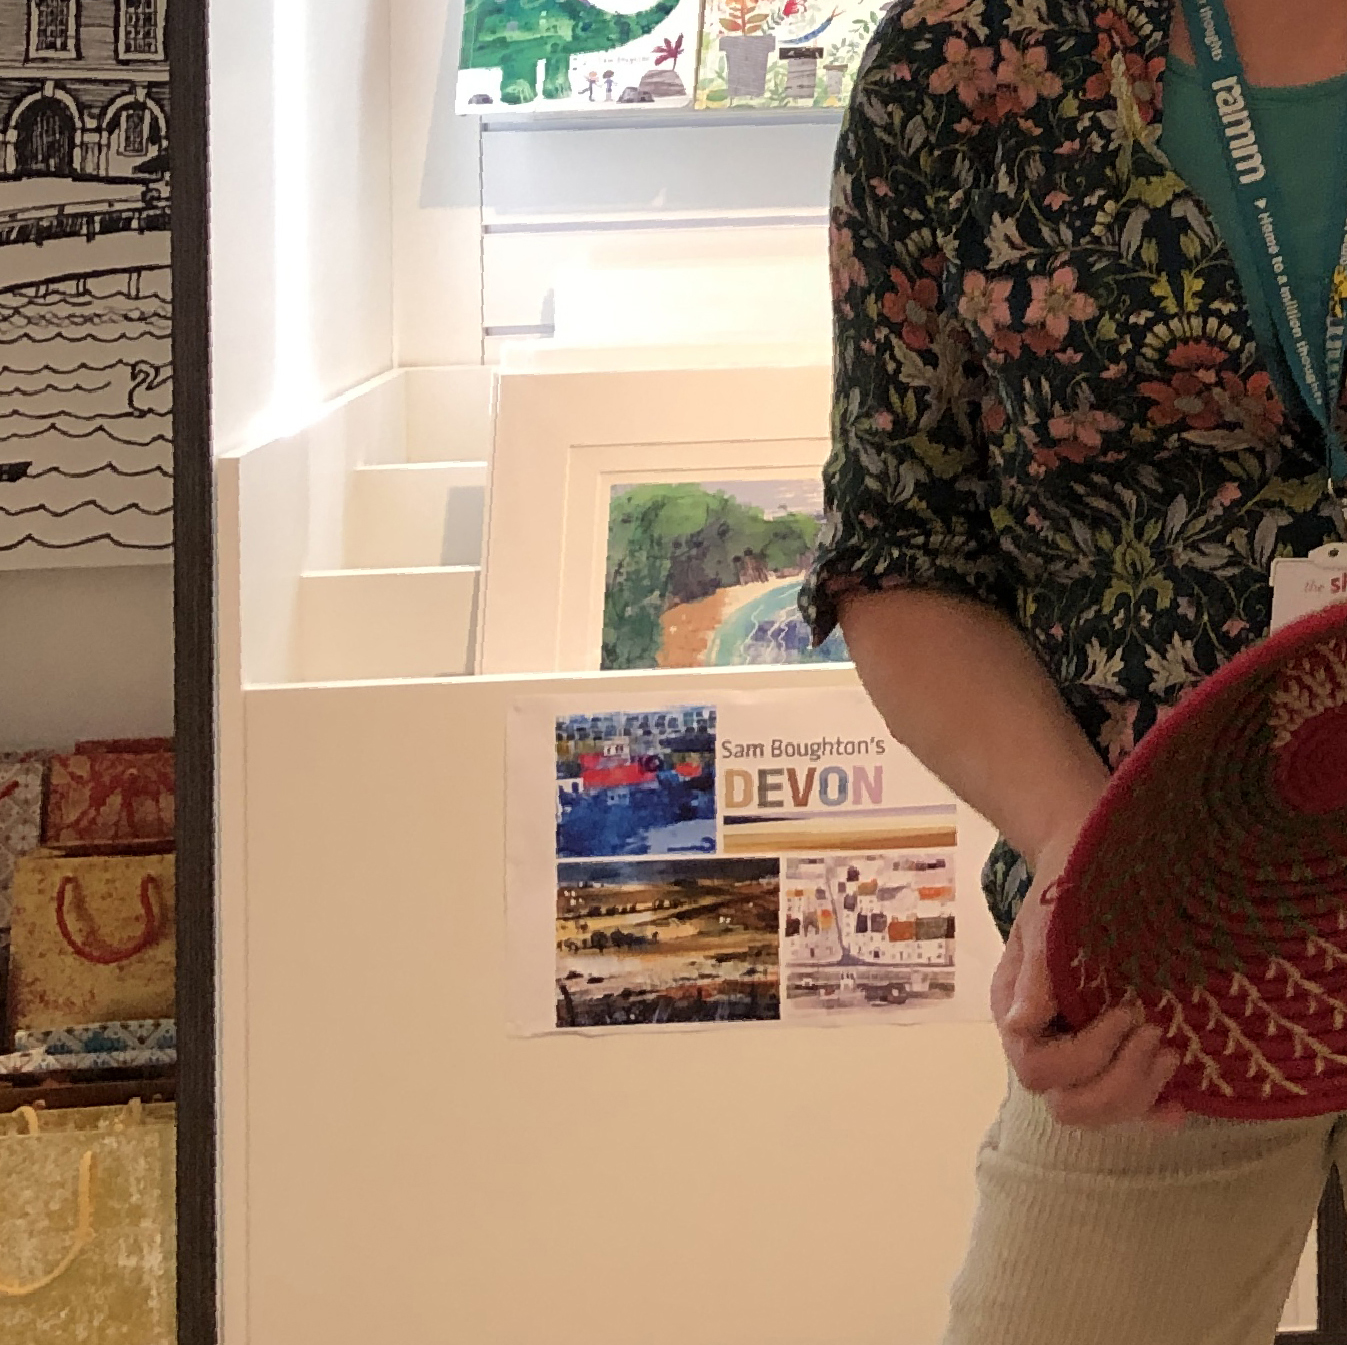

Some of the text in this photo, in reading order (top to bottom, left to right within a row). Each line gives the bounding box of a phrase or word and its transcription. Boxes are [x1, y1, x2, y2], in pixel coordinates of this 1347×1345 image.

[1200, 5, 1223, 62] thoughts
[1212, 76, 1323, 404] ramm Home to a million thoughts
[1304, 579, 1325, 593] the
[721, 736, 886, 762] Sam Boughton's
[724, 765, 883, 809] DEVON
